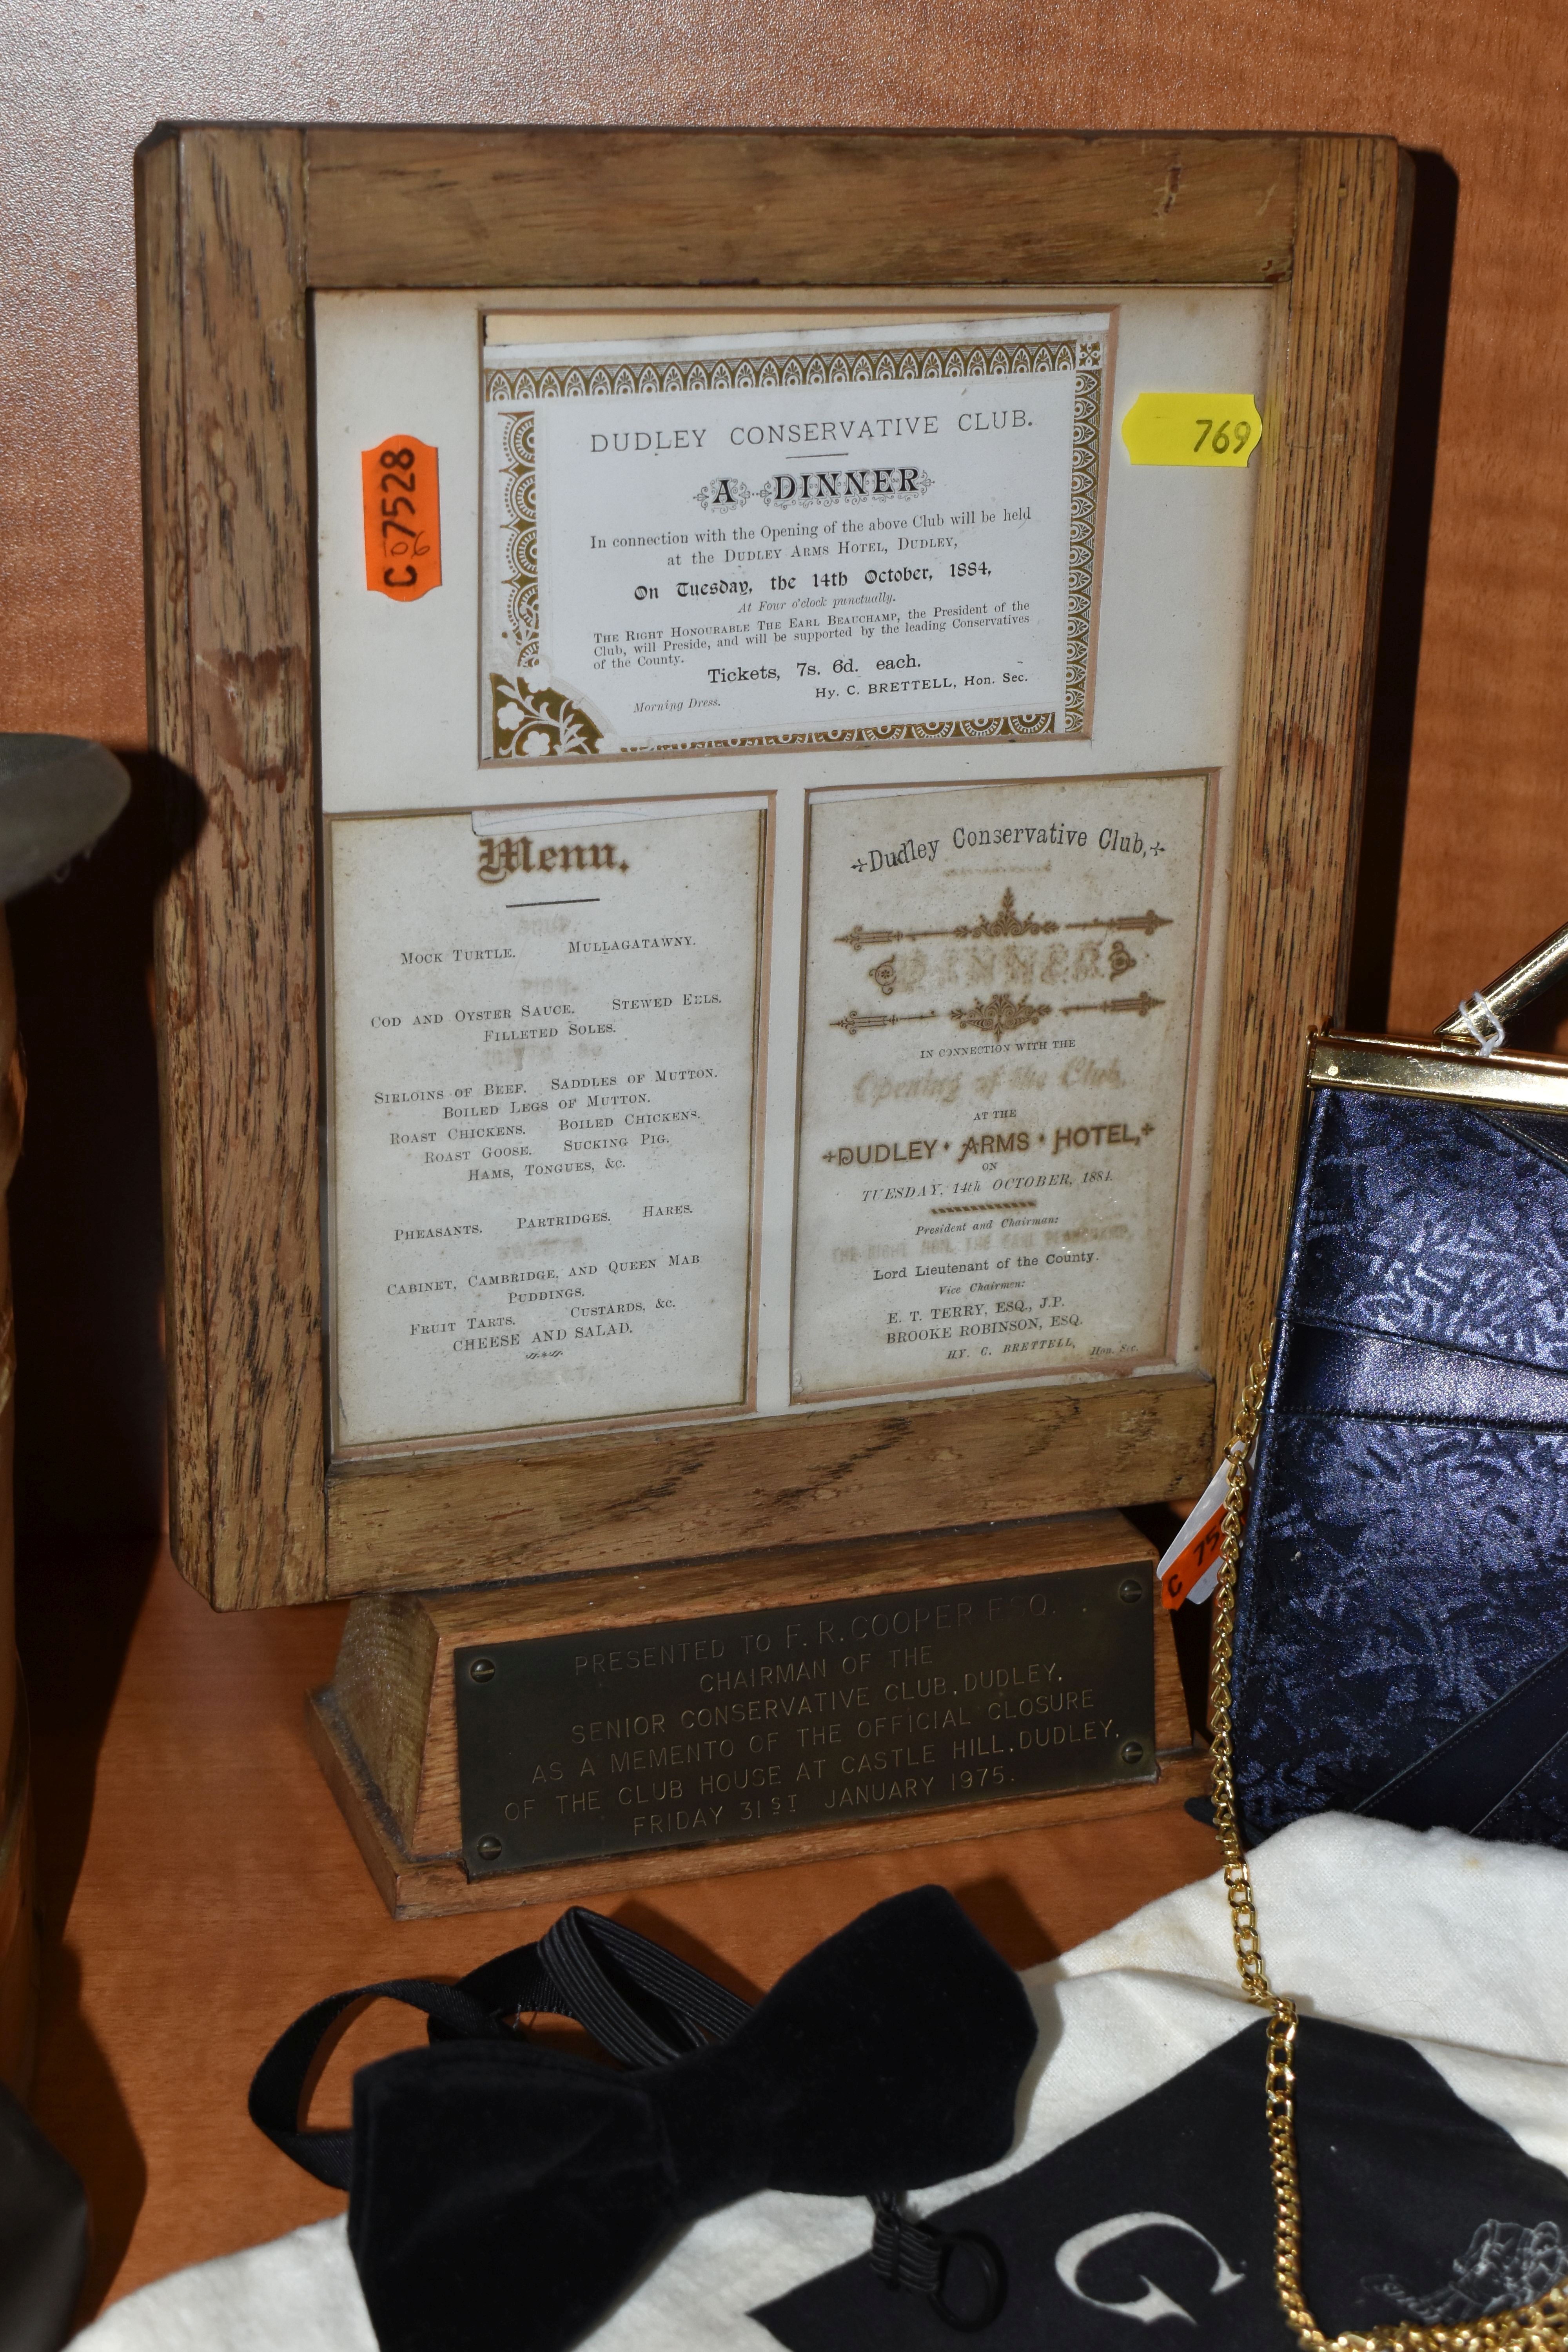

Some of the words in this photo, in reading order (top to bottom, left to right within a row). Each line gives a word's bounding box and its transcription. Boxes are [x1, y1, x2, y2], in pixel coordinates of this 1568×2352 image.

[590, 428, 706, 452] DUDLEY
[730, 416, 938, 445] CONSERVATIVE
[958, 410, 1033, 431] CLUB.
[1194, 419, 1251, 454] 769
[380, 448, 416, 538] 7528
[772, 467, 921, 505] DINNER
[590, 535, 606, 549] In
[613, 532, 688, 547] connection
[695, 528, 726, 543] with
[733, 527, 755, 541] the
[761, 523, 818, 542] Opening
[824, 521, 837, 534] of
[842, 519, 864, 533] the
[869, 518, 907, 531] above
[913, 514, 944, 528] Club
[950, 511, 975, 525] will
[981, 510, 995, 523] be
[1004, 507, 1031, 521] held
[383, 565, 418, 587] C
[668, 554, 681, 566] at
[691, 551, 714, 564] the
[634, 586, 659, 601] On
[676, 580, 753, 597] Tuesday,
[770, 575, 796, 590] the
[812, 572, 848, 588] 14th
[864, 567, 933, 584] October,
[950, 561, 991, 577] 1884,
[737, 603, 751, 613] At
[758, 601, 786, 612] Four
[792, 597, 827, 608] o'clock
[833, 592, 896, 608] punctually.
[908, 609, 926, 619] the
[934, 603, 987, 617] President
[995, 602, 1006, 612] of
[1012, 601, 1029, 611] the
[594, 645, 626, 657] Club,
[634, 642, 656, 653] will
[664, 639, 710, 651] Preside,
[717, 636, 738, 647] and
[746, 633, 767, 644] will
[773, 632, 786, 642] be
[794, 627, 852, 642] supported
[861, 626, 875, 638] by
[881, 624, 899, 634] the
[906, 621, 946, 632] leading
[953, 615, 1029, 629] Conservatives
[593, 659, 606, 670] of
[612, 658, 630, 668] the
[637, 654, 684, 666] County.
[708, 666, 780, 683] Tickets,
[797, 662, 820, 677] 7s.
[833, 658, 858, 673] 6d.
[876, 654, 920, 670] each.
[815, 688, 839, 699] Hy.
[847, 685, 859, 695] C.
[868, 678, 956, 694] BRETTELL,
[964, 675, 995, 686] Hon.
[1003, 673, 1027, 682] Sec.
[633, 702, 683, 713] Morning
[688, 698, 720, 708] Dress.
[478, 836, 630, 884] Menu.
[868, 839, 940, 872] Dudley
[953, 822, 1087, 849] Conservative
[1099, 828, 1146, 858] Club,
[920, 1050, 934, 1058] IN
[1014, 1040, 1047, 1051] WITH
[1052, 1039, 1075, 1049] THE
[973, 1112, 988, 1122] AT
[993, 1109, 1016, 1120] THE
[837, 1139, 937, 1166] DUDLEY
[957, 1131, 1029, 1163] ARMS
[1051, 1123, 1140, 1155] HOTEL,
[915, 1223, 966, 1235] President
[972, 1220, 993, 1230] and
[1001, 1217, 1059, 1228] Chairman:
[873, 1267, 907, 1281] Lord
[915, 1260, 989, 1276] Lieutenant
[996, 1258, 1011, 1269] of
[1016, 1256, 1038, 1267] the
[887, 1312, 901, 1324] E.
[910, 1311, 922, 1321] T.
[1040, 1296, 1064, 1308] J.P.
[453, 1334, 520, 1352] CHEESE
[531, 1329, 566, 1343] AND
[575, 1323, 633, 1339] SALAD.
[886, 1327, 951, 1344] BROOKE
[959, 1318, 1042, 1337] ROBINSON,
[1049, 1314, 1083, 1327] ESQ.
[1168, 1574, 1183, 1598] C
[575, 1639, 725, 1675] PRESENTED
[741, 1634, 770, 1654] TO
[701, 1659, 826, 1692] CHAIRMAN
[842, 1653, 871, 1674] OF
[891, 1646, 933, 1668] THE
[572, 1714, 664, 1744] SENIOR
[681, 1688, 869, 1729] CONSERVATIVE
[532, 1762, 563, 1784] AS
[581, 1758, 595, 1777] A
[611, 1739, 733, 1773] MEMENTO
[750, 1733, 778, 1752] OF
[797, 1724, 841, 1747] THE
[858, 1708, 971, 1739] OFFICIAL
[988, 1689, 1094, 1720] CLOSURE
[505, 1799, 534, 1820] OF
[556, 1791, 601, 1814] THE
[619, 1780, 682, 1805] CLUB
[701, 1766, 780, 1795] HOUSE
[797, 1759, 826, 1782] AT
[842, 1745, 935, 1774] CASTLE
[634, 1806, 722, 1836] FRIDAY
[825, 1777, 934, 1808] JANUARY
[952, 1766, 1015, 1791] 1975.
[1055, 2211, 1246, 2326] G
